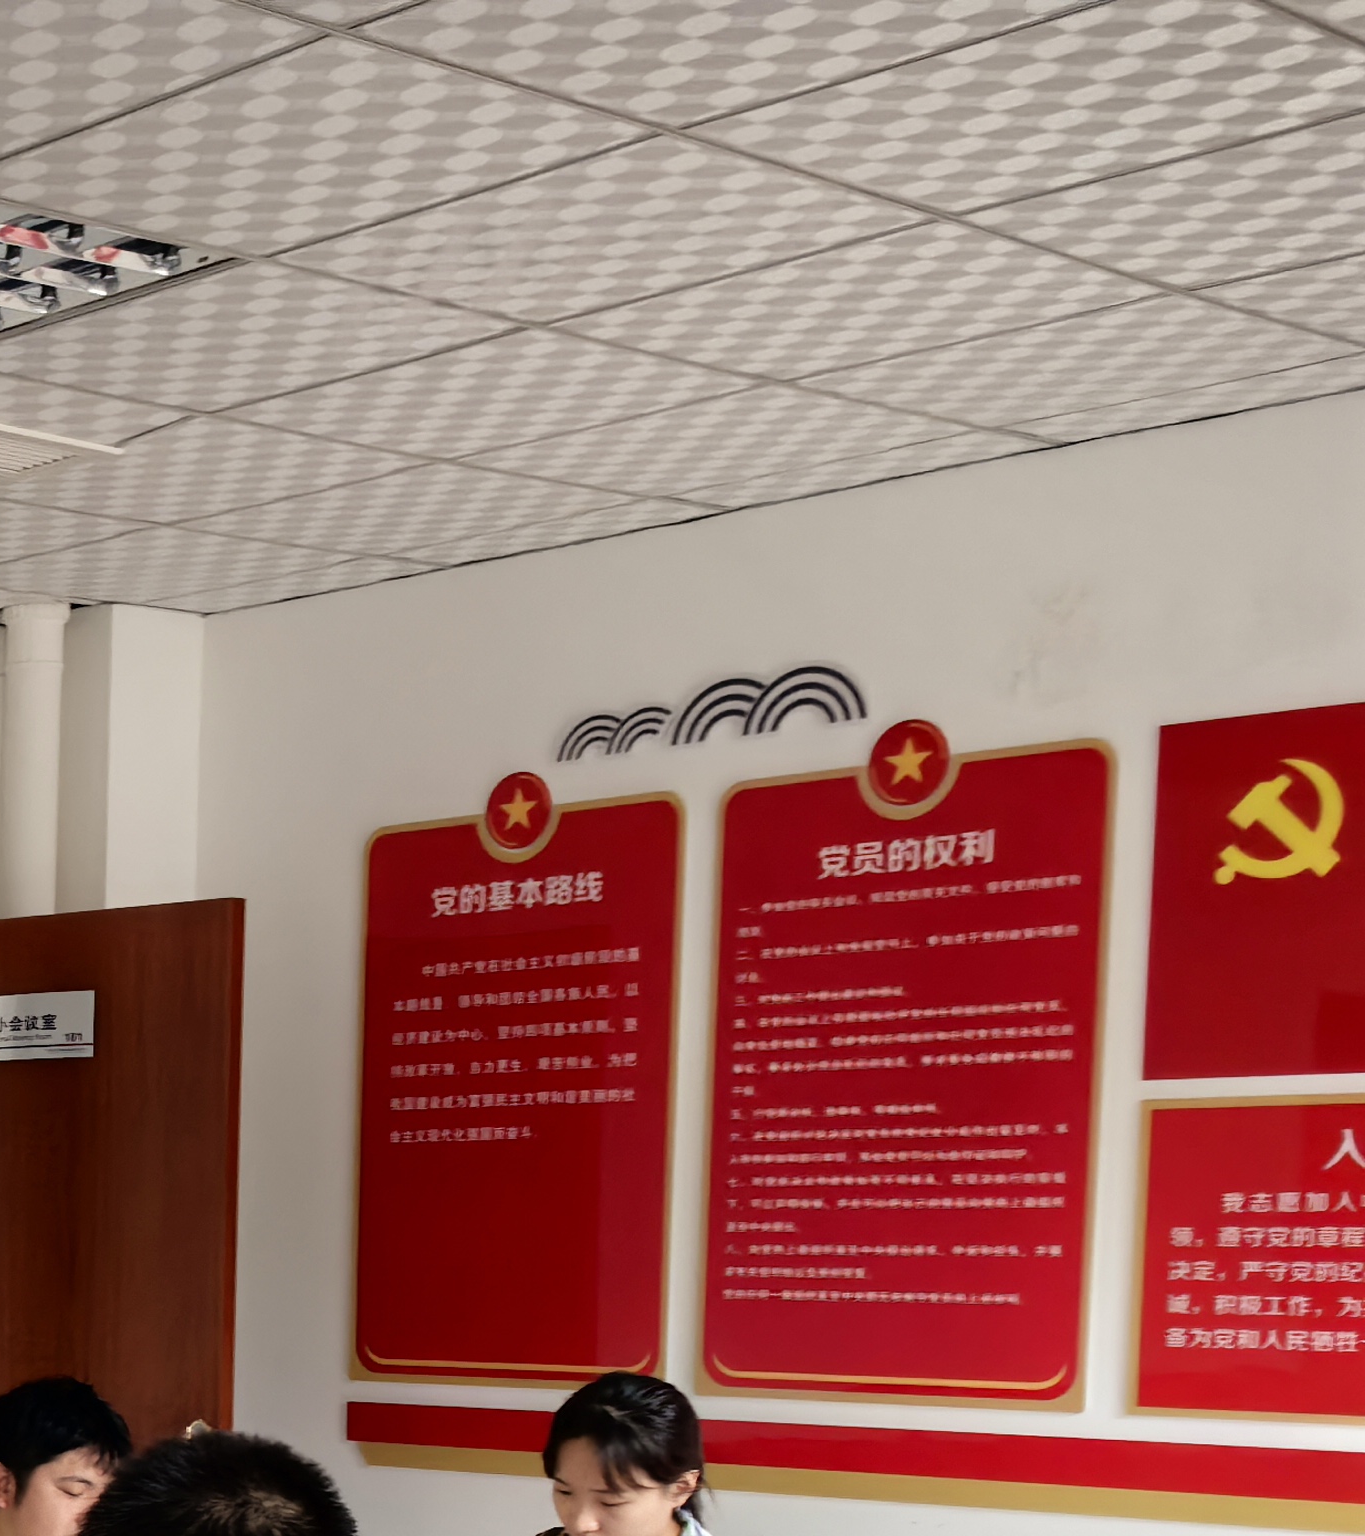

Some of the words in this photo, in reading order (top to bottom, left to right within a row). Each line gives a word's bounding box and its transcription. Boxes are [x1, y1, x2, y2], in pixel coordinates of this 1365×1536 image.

[817, 829, 996, 880] 党员的权利
[431, 870, 604, 918] 党的基本路线
[1167, 1260, 1365, 1282] 决定，严守党的纪
[1166, 1294, 1365, 1318] 诚，积极工作，为
[1164, 1328, 1365, 1352] 备为党和人民牺牲
